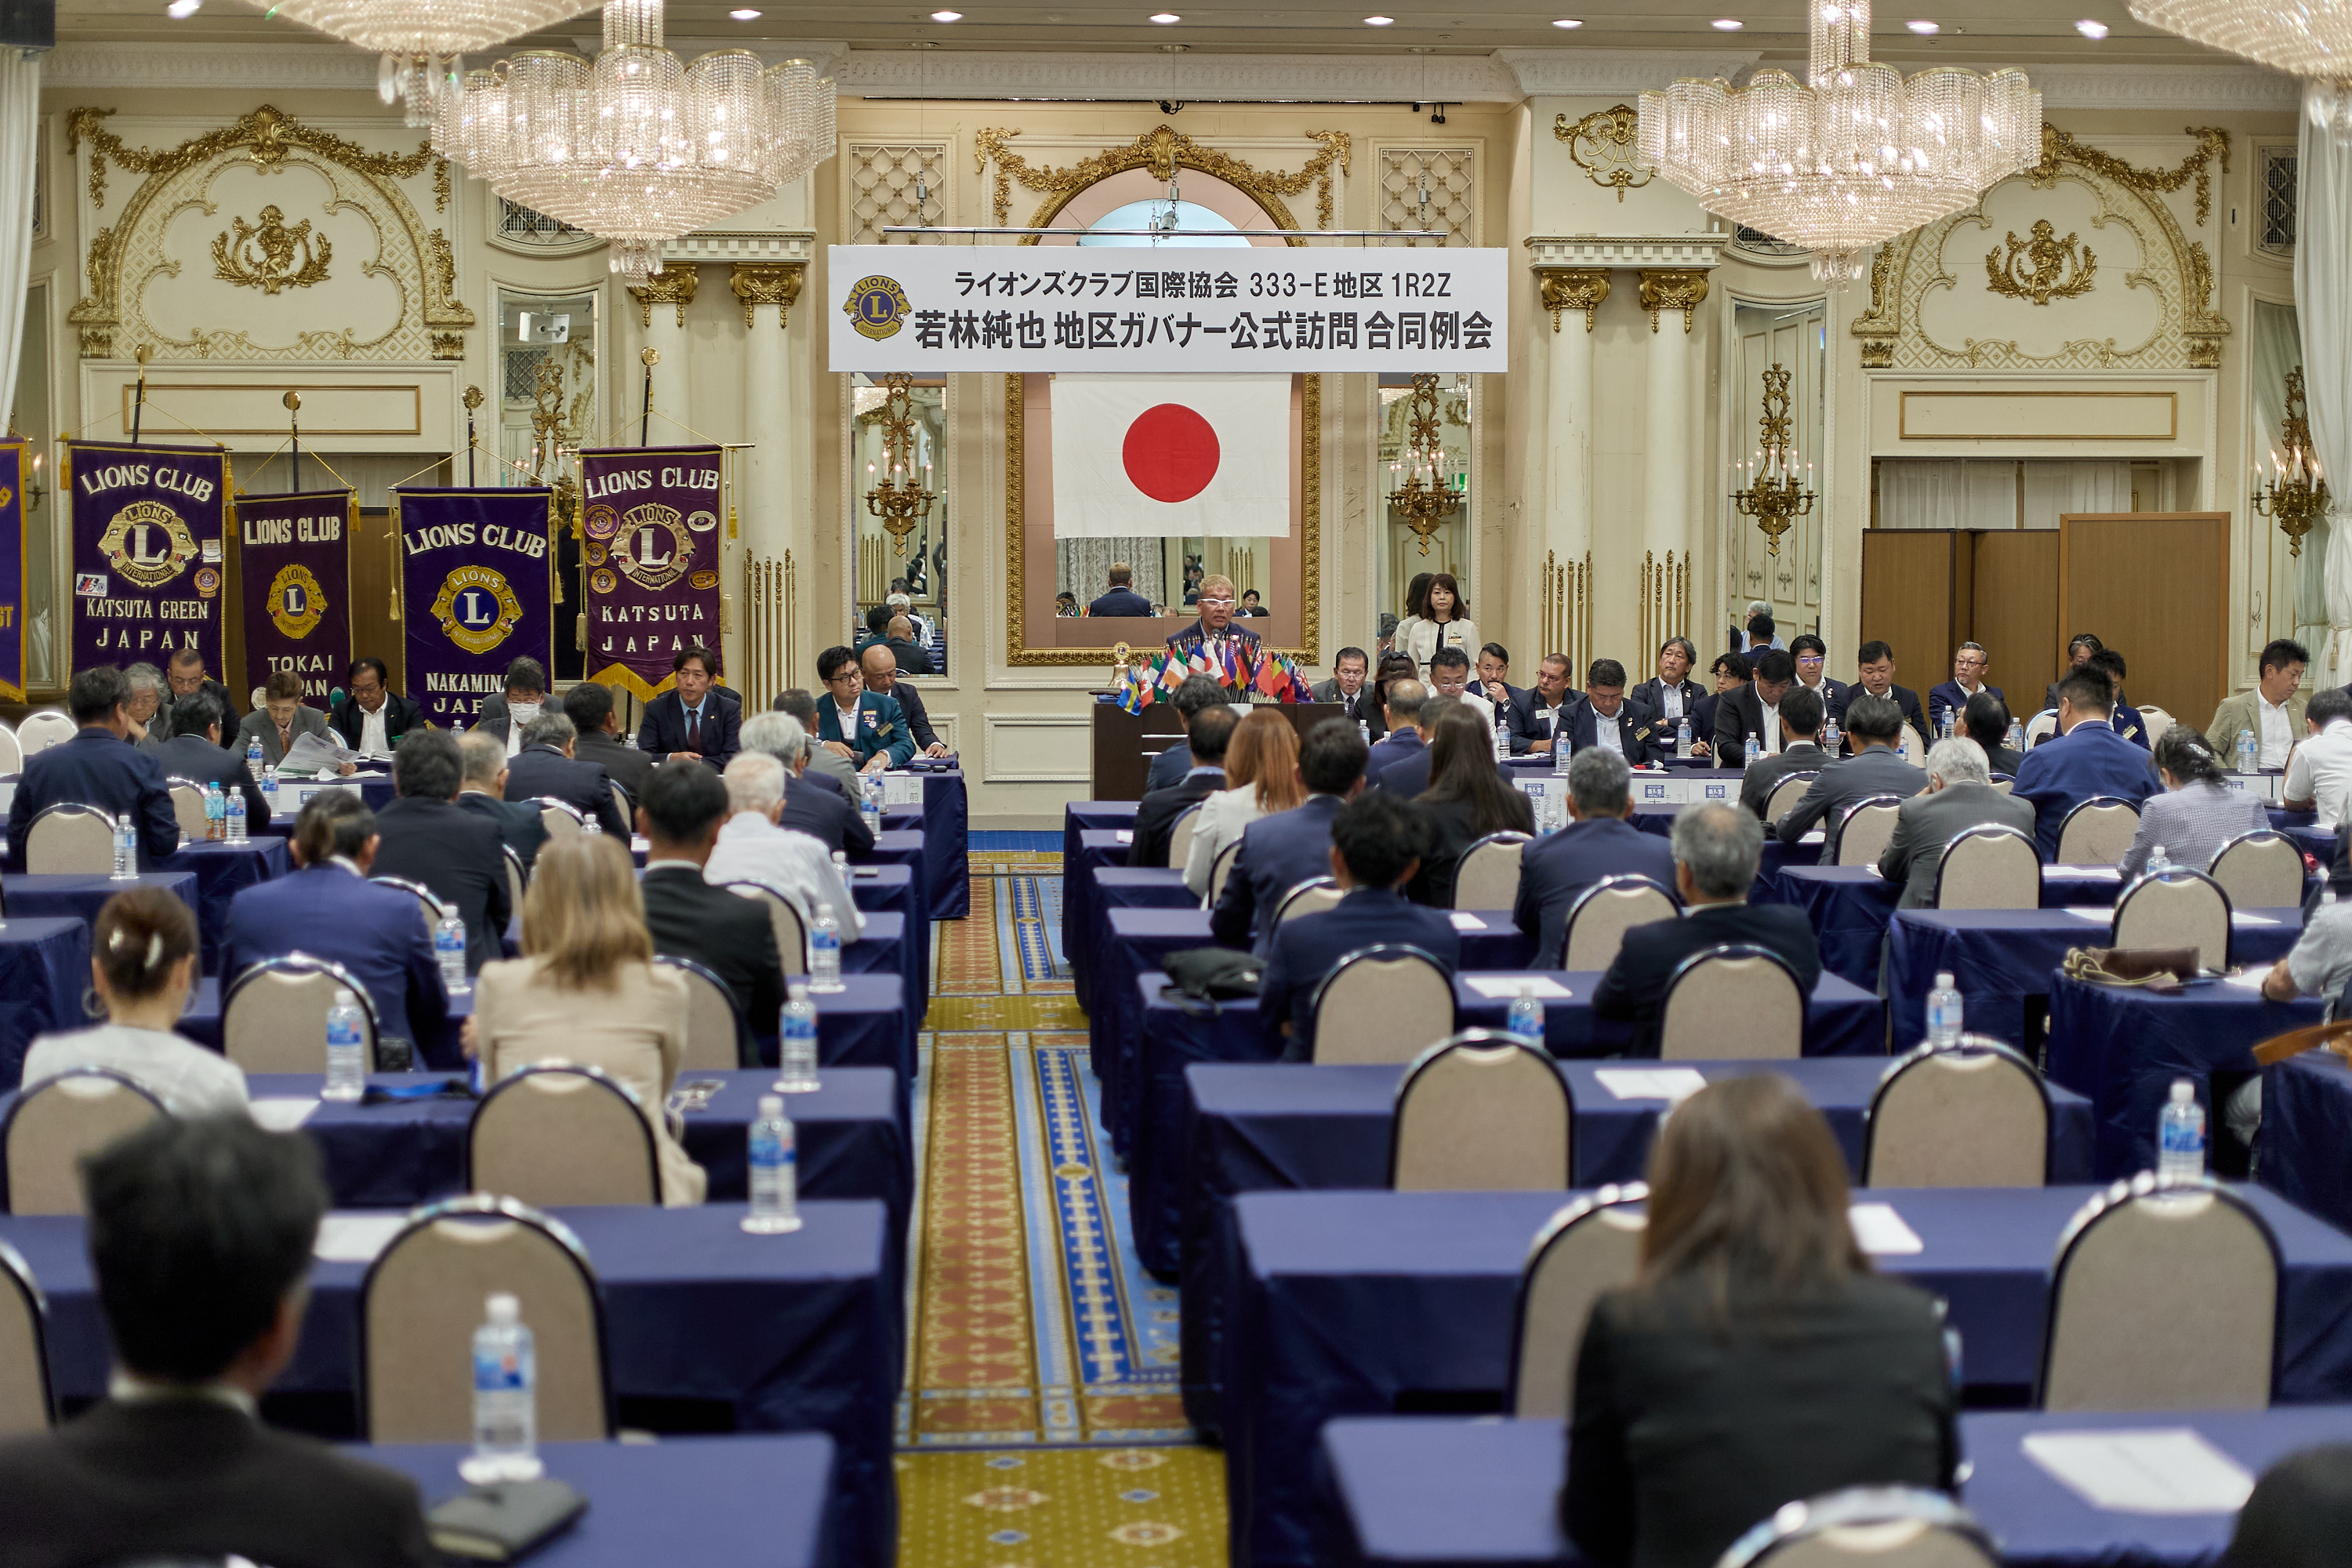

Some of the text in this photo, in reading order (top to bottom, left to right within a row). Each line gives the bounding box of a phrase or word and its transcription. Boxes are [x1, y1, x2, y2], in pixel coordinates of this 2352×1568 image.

[858, 278, 897, 292] LIONS
[955, 270, 1238, 298] ライオンズクラブ国際協会
[1392, 272, 1451, 297] 1R2Z
[870, 296, 887, 318] L
[858, 325, 897, 336] INTERNATIONAL
[80, 465, 213, 503] LIONS CLUB
[585, 466, 719, 499] LIONS CLUB
[127, 506, 172, 524] LIONS
[630, 506, 675, 524] LIONS
[245, 516, 340, 545] LIONS CLUB
[132, 524, 167, 563] L
[402, 523, 547, 559] LIONS CLUB
[639, 528, 671, 565] L
[122, 563, 175, 580] INTERNATIONAL
[281, 569, 308, 584] LIONS
[452, 571, 500, 588] LIONS
[632, 568, 678, 585] INTERNATIONAL
[86, 598, 209, 619] KATSUTA GREEN
[287, 589, 304, 612] L
[463, 593, 490, 624] L
[601, 604, 704, 622] KATSUTA
[280, 617, 311, 631] INTERNATIONAL
[96, 628, 198, 649] JAPAN
[452, 629, 503, 645] INTERNATIONAL
[601, 634, 704, 652] JAPAN
[267, 655, 332, 673] TOKAI
[434, 698, 484, 714] JAP
